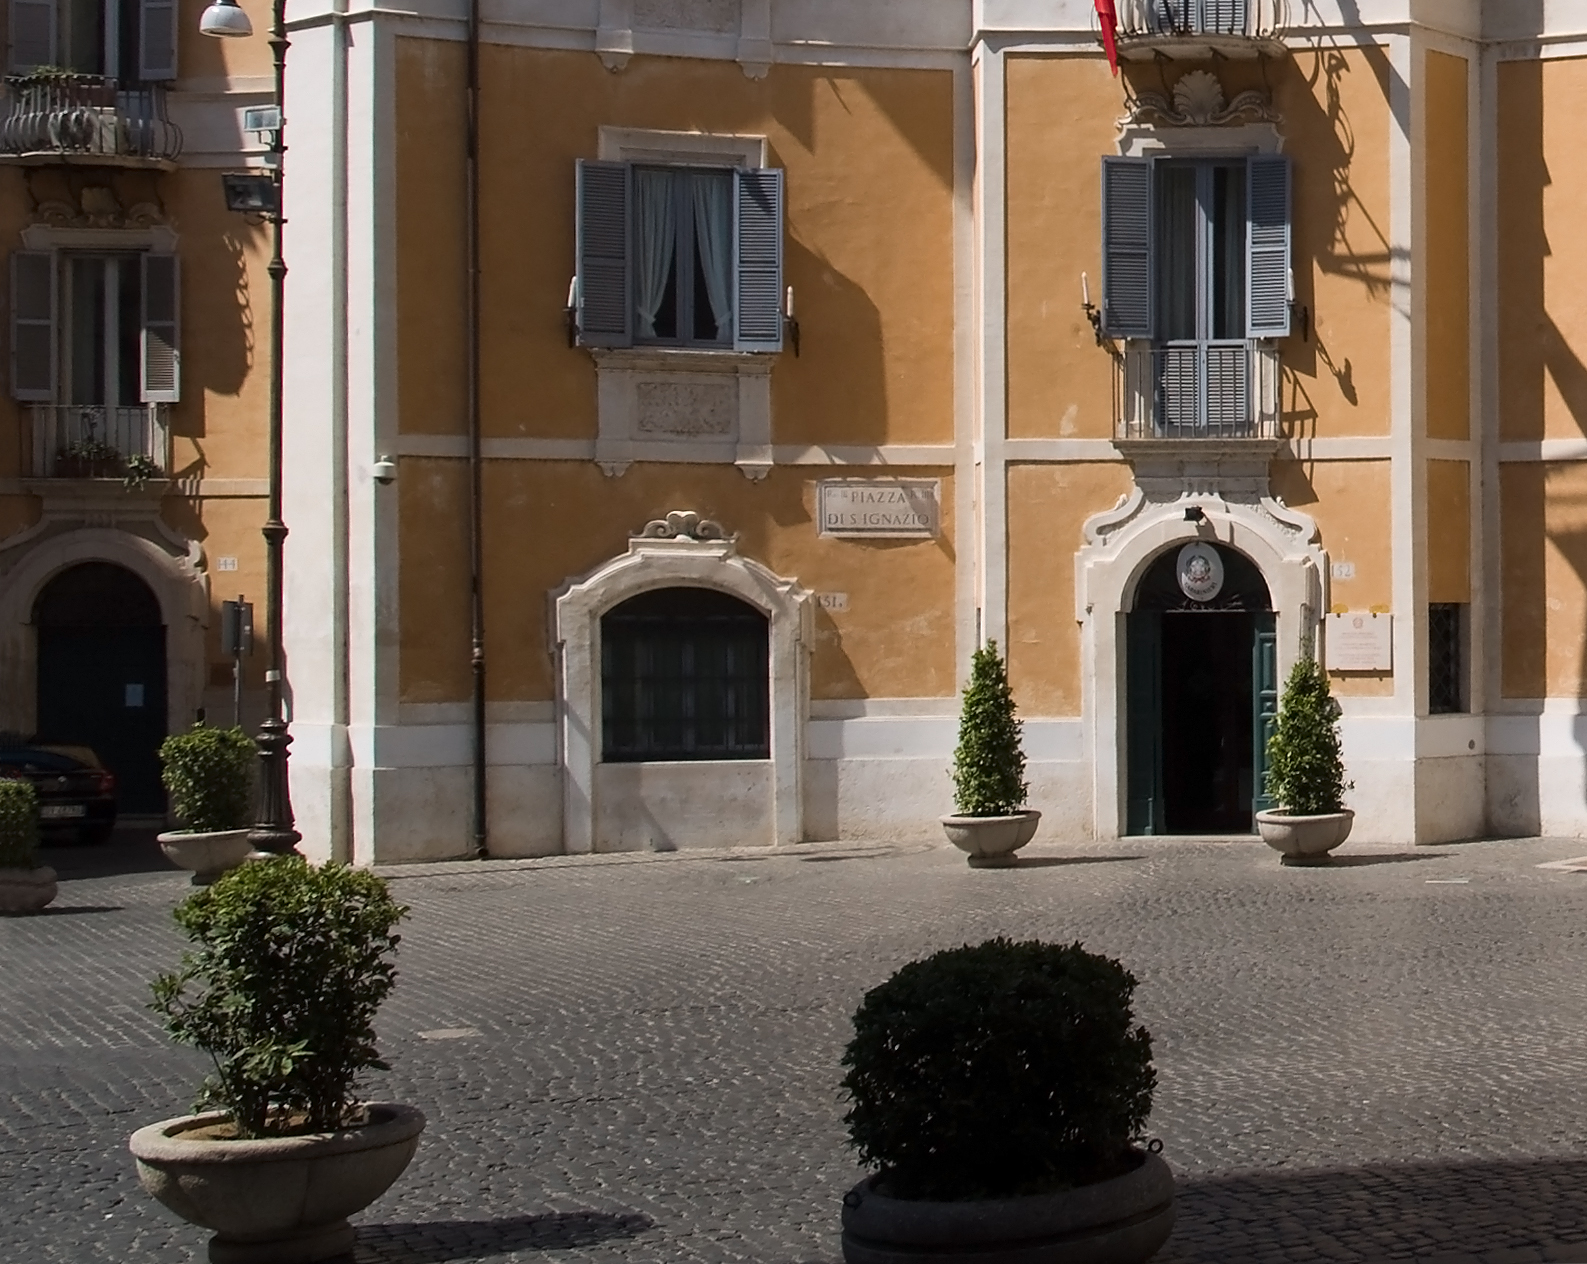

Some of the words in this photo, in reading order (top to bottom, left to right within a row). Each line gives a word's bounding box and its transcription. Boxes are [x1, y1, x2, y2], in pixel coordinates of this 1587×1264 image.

[851, 491, 906, 503] PIAZZA
[828, 513, 844, 525] DI
[863, 513, 929, 525] IGNAZIO
[1331, 564, 1351, 577] 152
